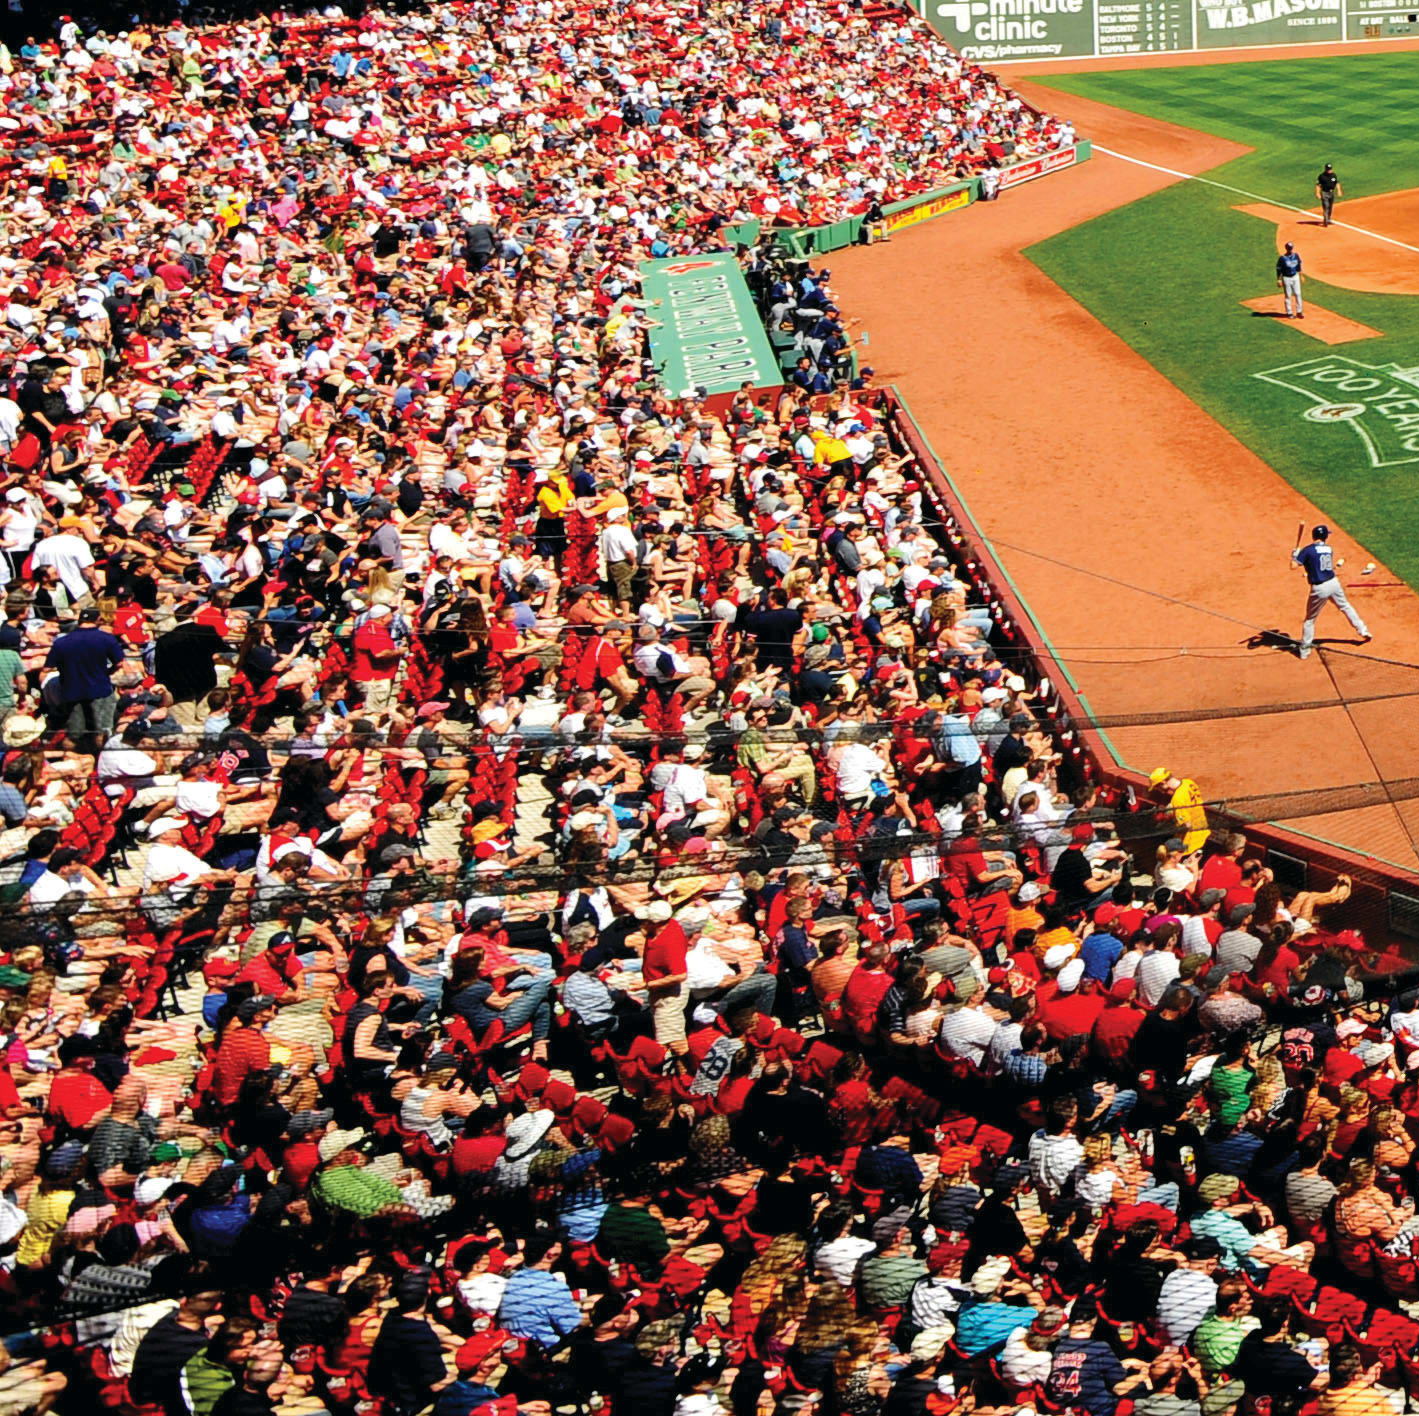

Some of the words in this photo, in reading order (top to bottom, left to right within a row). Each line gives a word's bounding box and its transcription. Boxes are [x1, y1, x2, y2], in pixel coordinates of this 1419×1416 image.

[975, 15, 1048, 41] clinic
[961, 44, 1063, 59] CVS/pharmacy
[667, 274, 743, 340] FENWAY
[680, 335, 761, 390] PARK
[1297, 365, 1381, 392] 100
